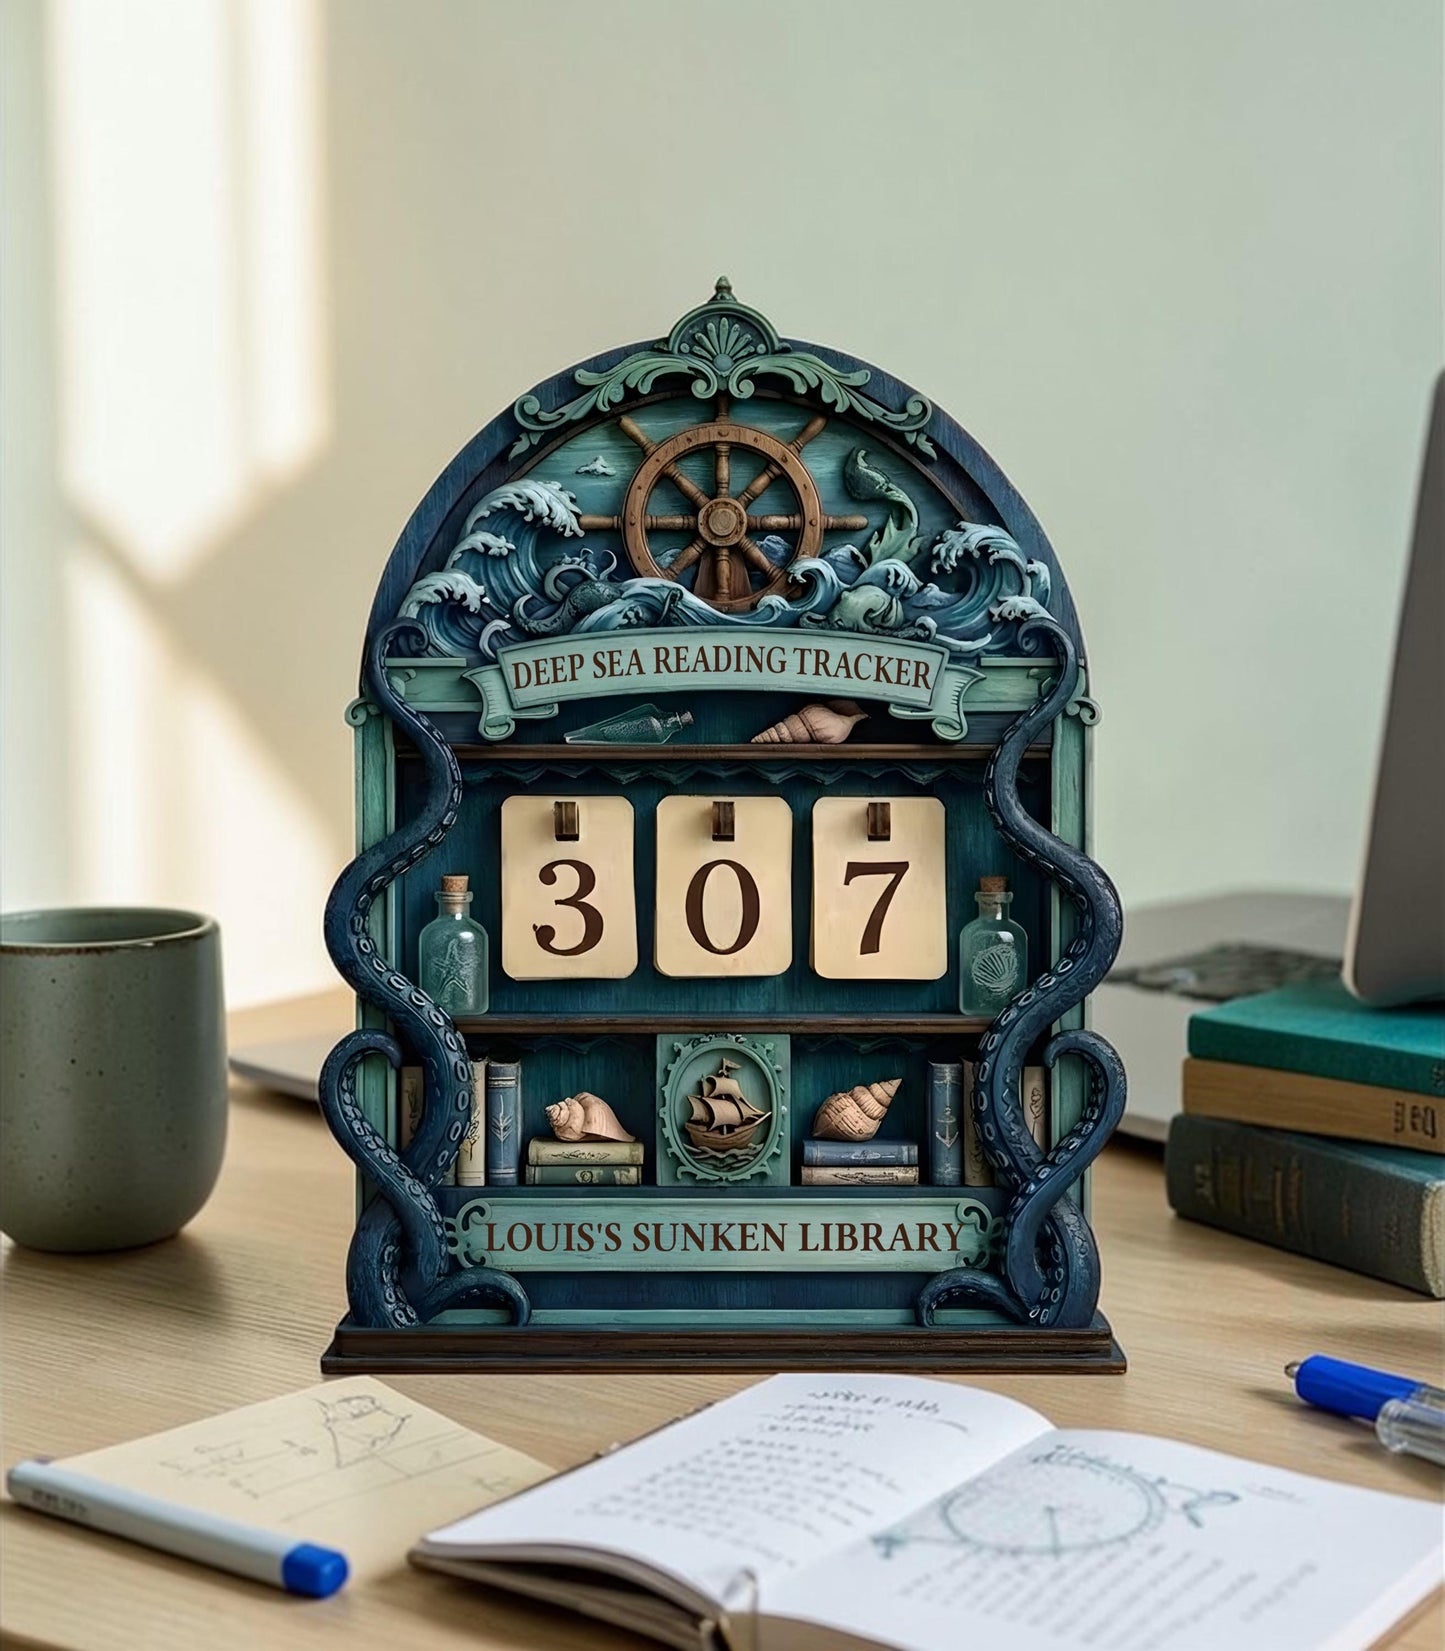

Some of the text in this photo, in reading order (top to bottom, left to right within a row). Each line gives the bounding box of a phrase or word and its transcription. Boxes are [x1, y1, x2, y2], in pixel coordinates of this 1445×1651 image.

[512, 645, 932, 690] DEEP SEA READING TRACKER
[532, 859, 909, 956] 3 0 7
[485, 1222, 965, 1252] LOUIS'S SUNKEN LIBRARY
